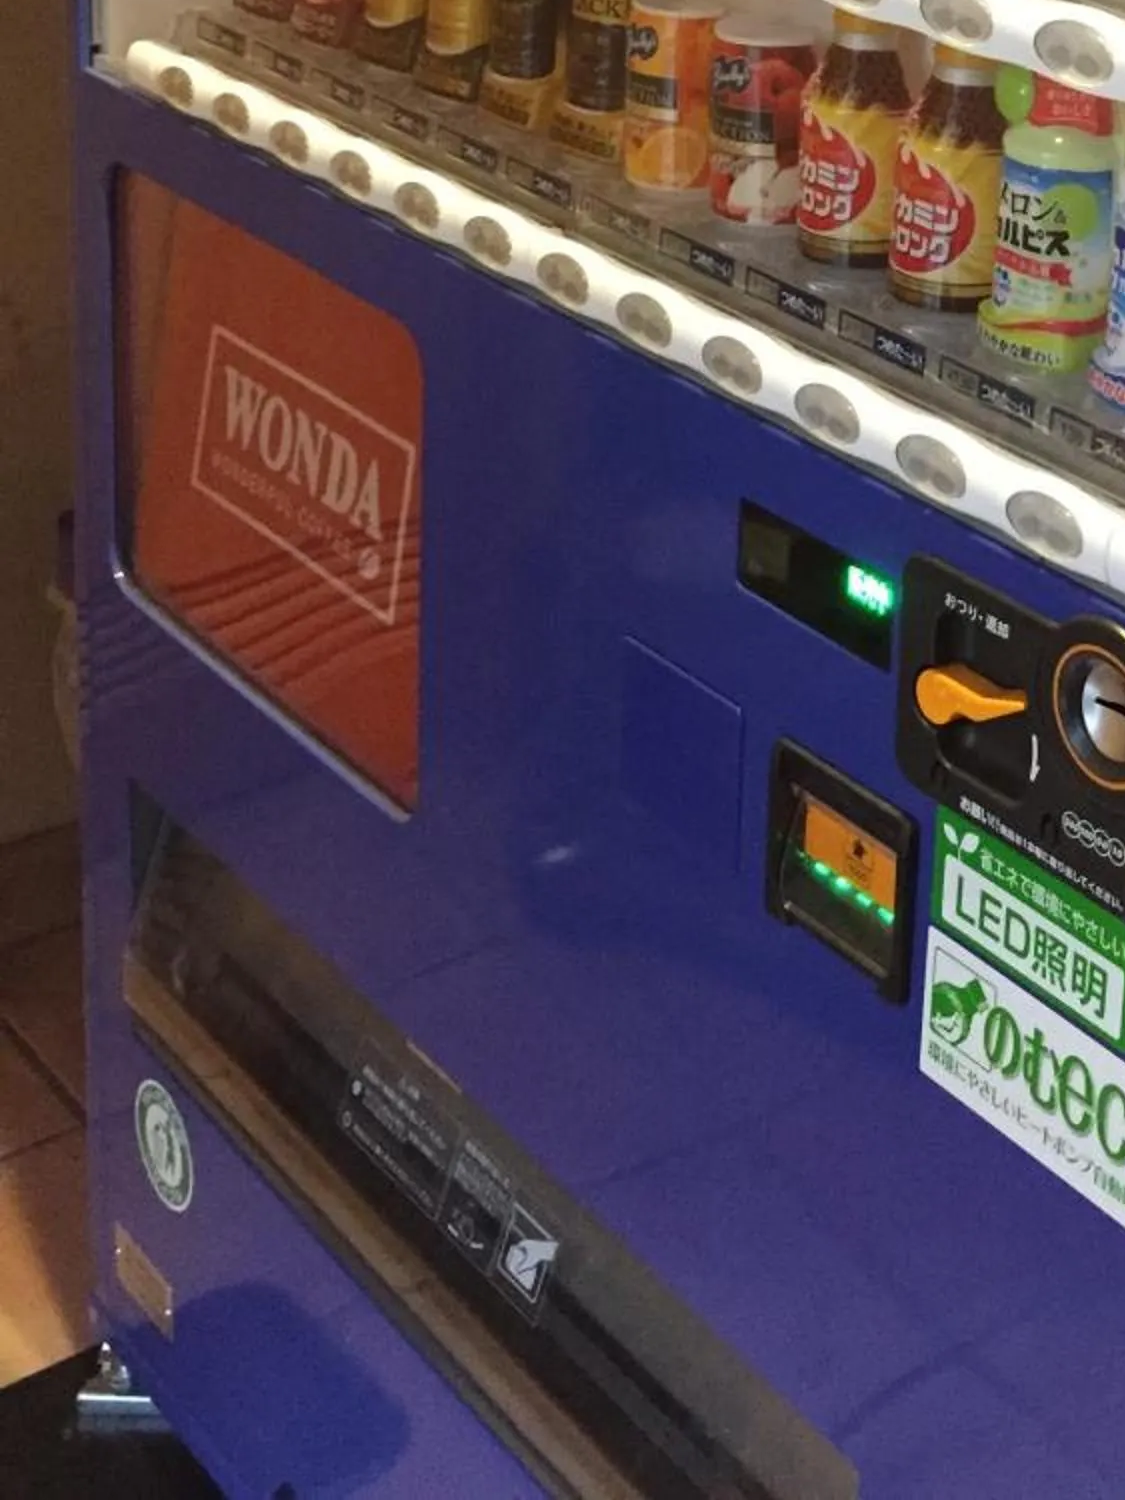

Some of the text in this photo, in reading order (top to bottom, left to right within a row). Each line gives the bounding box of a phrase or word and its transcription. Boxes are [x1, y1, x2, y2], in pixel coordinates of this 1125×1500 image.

[895, 226, 951, 263] ロング
[898, 194, 959, 233] カミン
[225, 364, 383, 542] WONDA
[956, 873, 1108, 1020] LED照明
